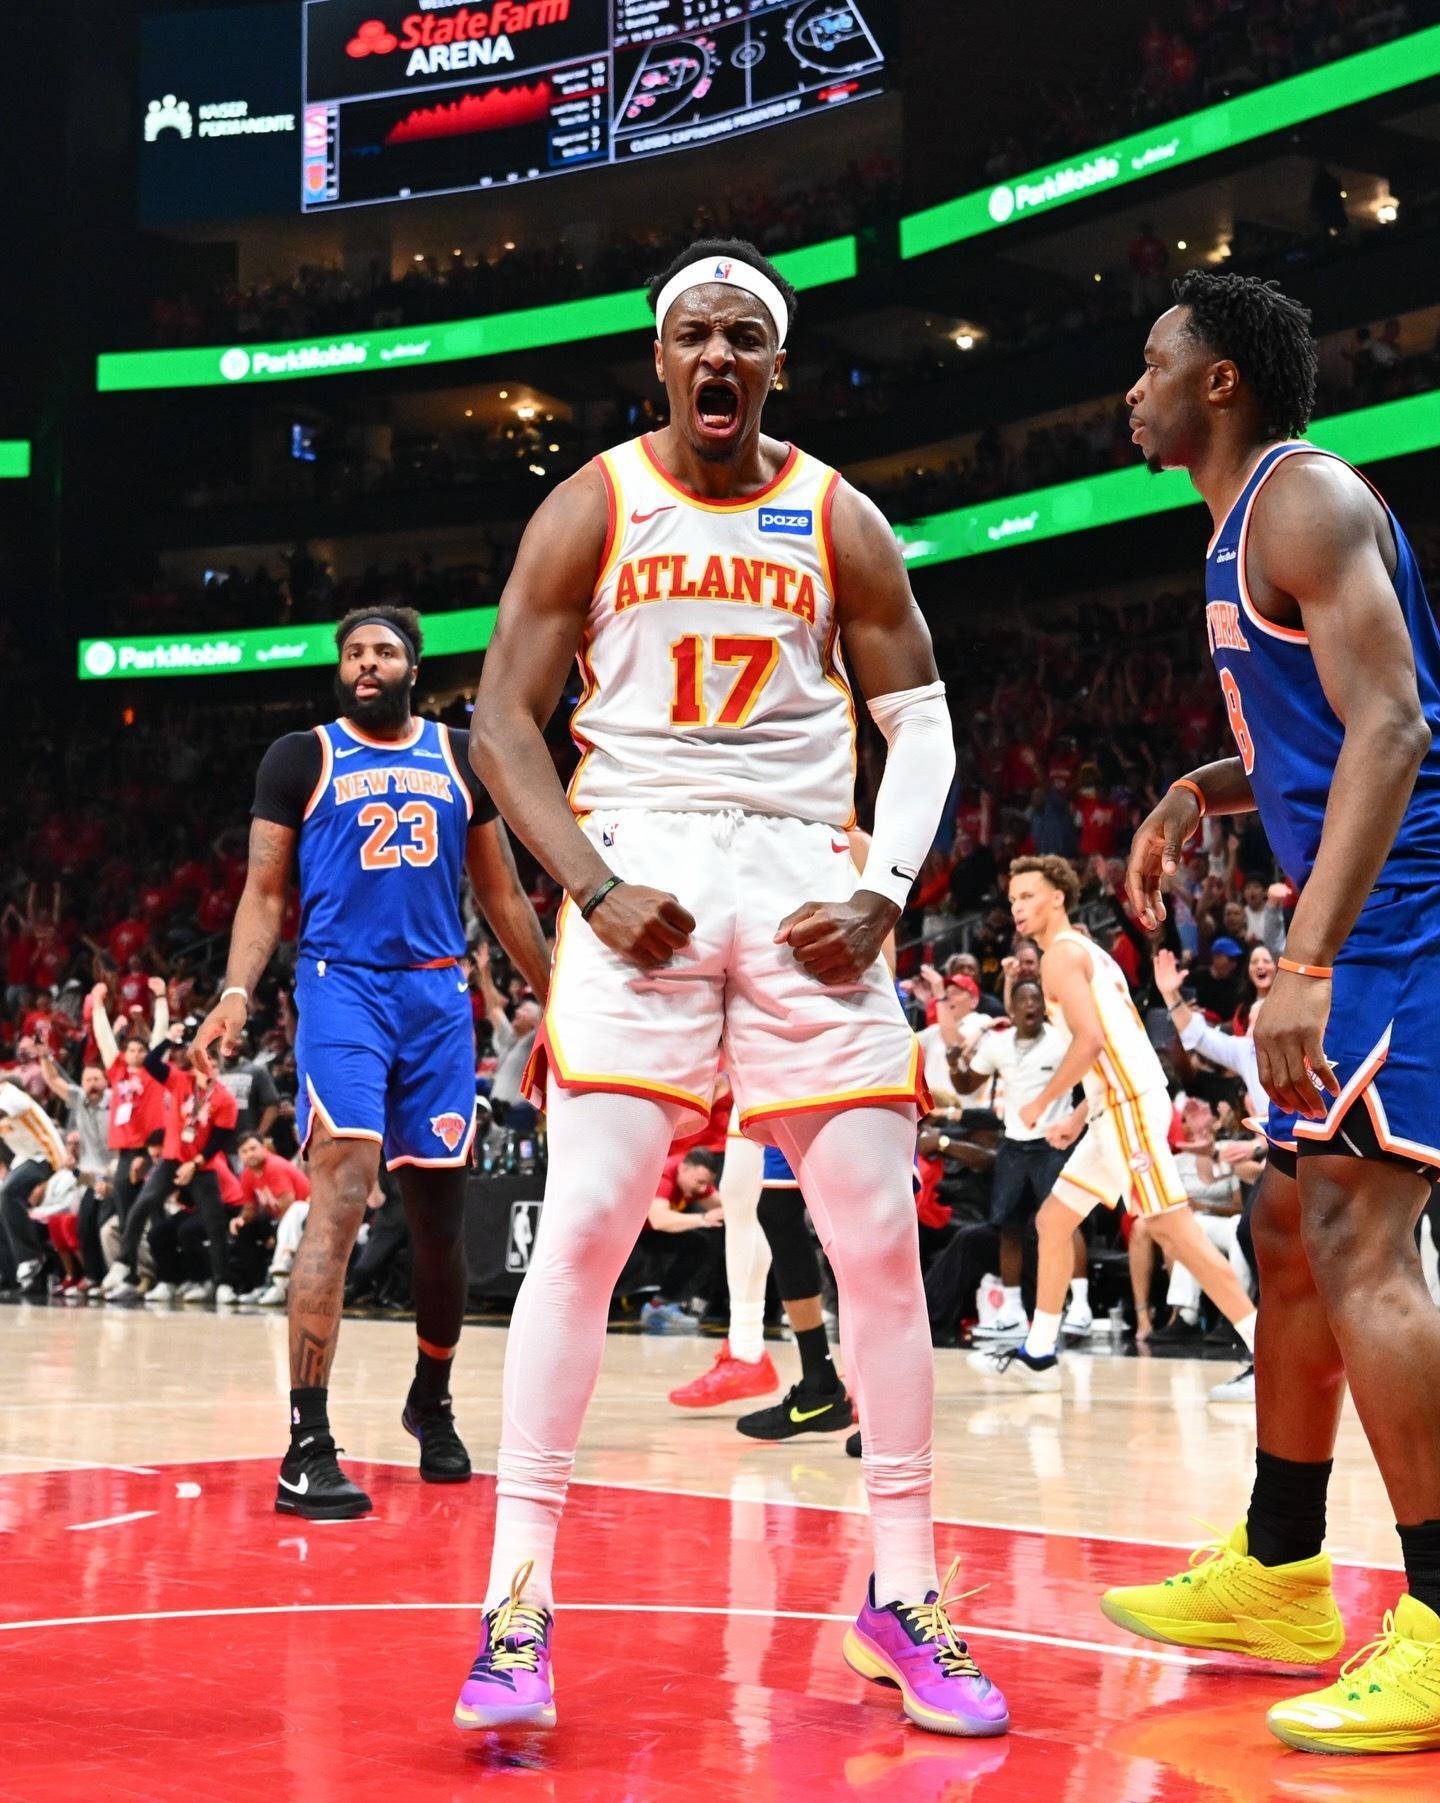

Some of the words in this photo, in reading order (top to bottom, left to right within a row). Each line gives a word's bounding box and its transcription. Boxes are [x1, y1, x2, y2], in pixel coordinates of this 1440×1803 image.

[406, 35, 515, 76] ARENA
[1016, 158, 1118, 209] ParkMobile
[253, 344, 366, 373] ParkMobile
[761, 514, 809, 528] paze
[614, 553, 817, 627] ATLANTA
[119, 643, 241, 668] ParkMobile
[669, 633, 780, 729] 17
[333, 767, 390, 806] NEW
[390, 767, 453, 804] YORK
[357, 800, 439, 871] 23
